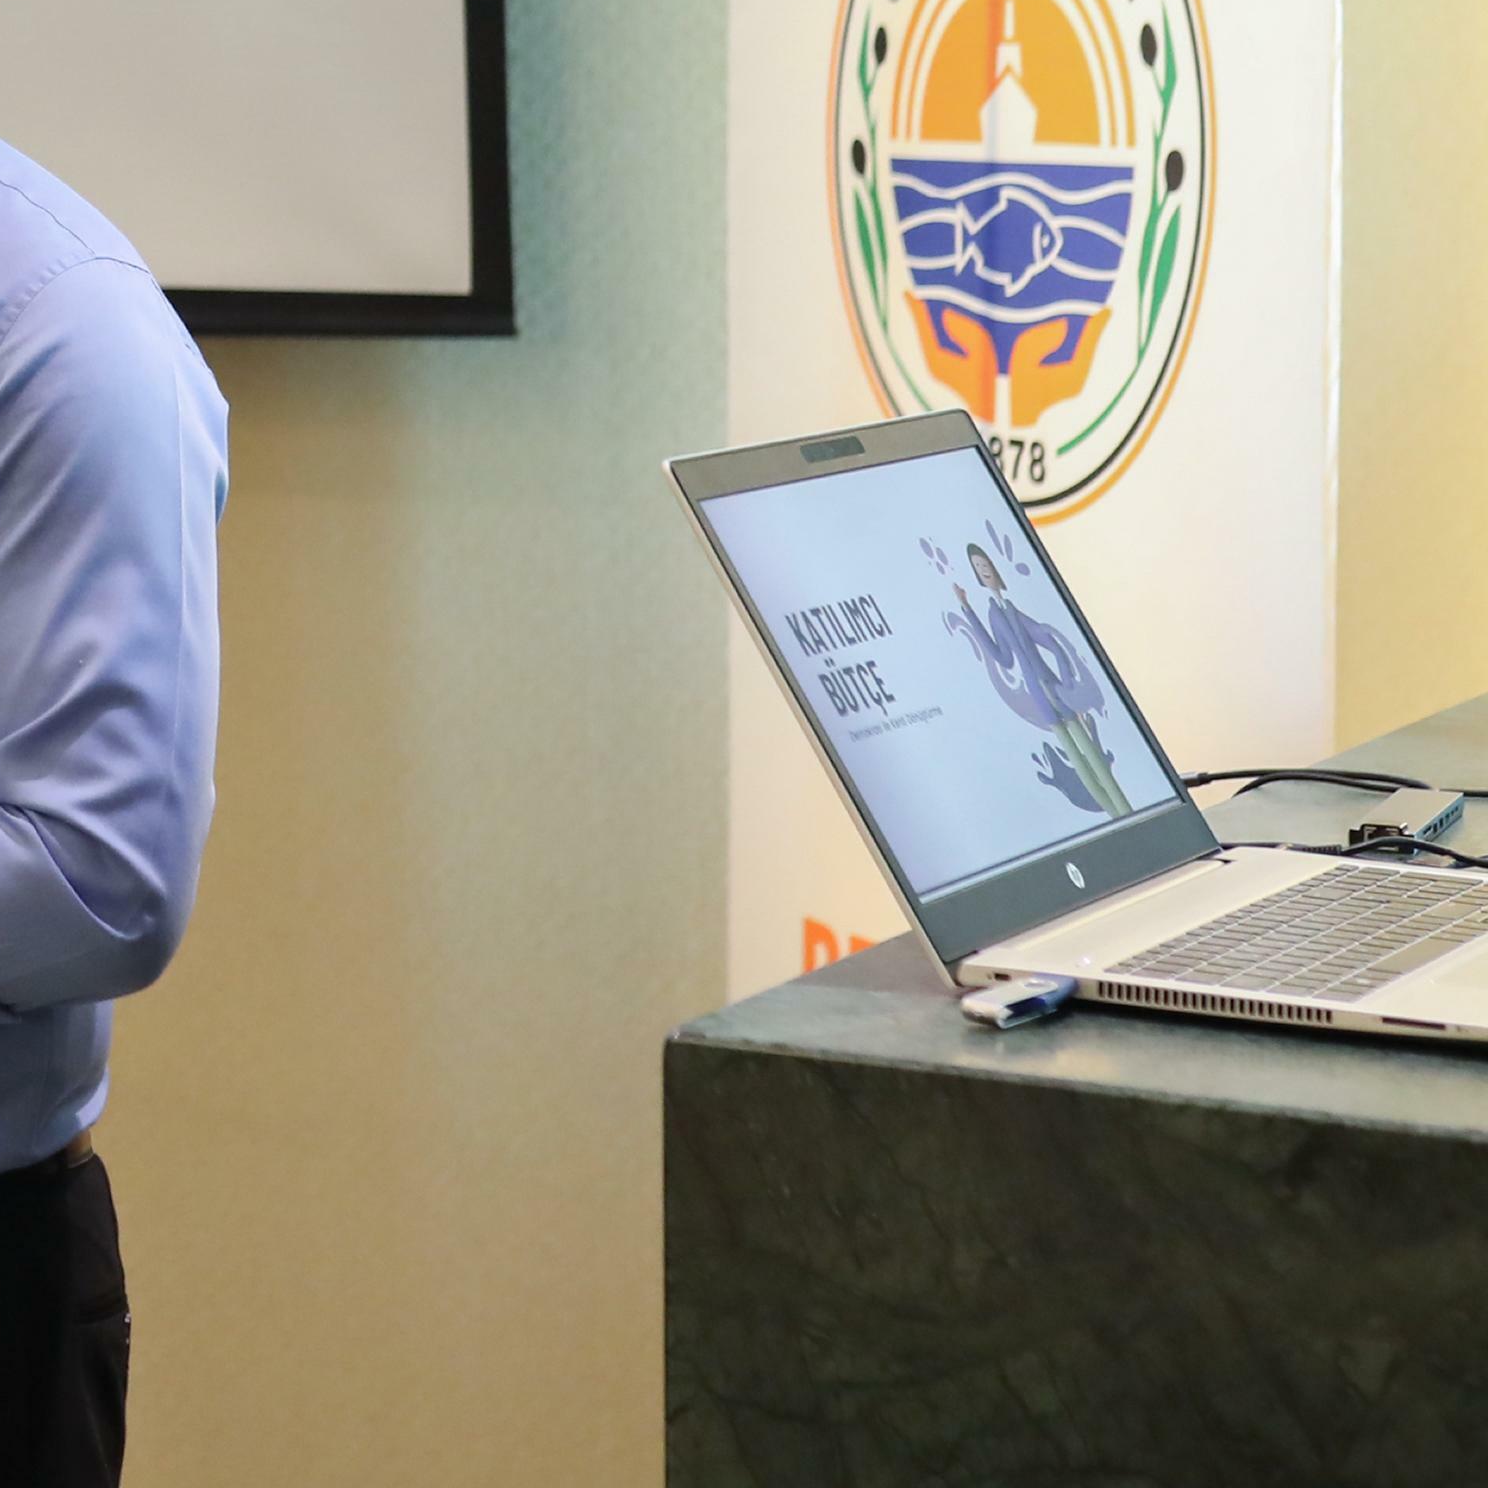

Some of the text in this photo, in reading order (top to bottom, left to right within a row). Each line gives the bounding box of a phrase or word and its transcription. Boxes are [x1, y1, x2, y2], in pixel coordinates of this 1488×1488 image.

[989, 435, 1046, 484] 878
[784, 593, 893, 657] KATILIMCI
[817, 656, 896, 717] BÜTÇE
